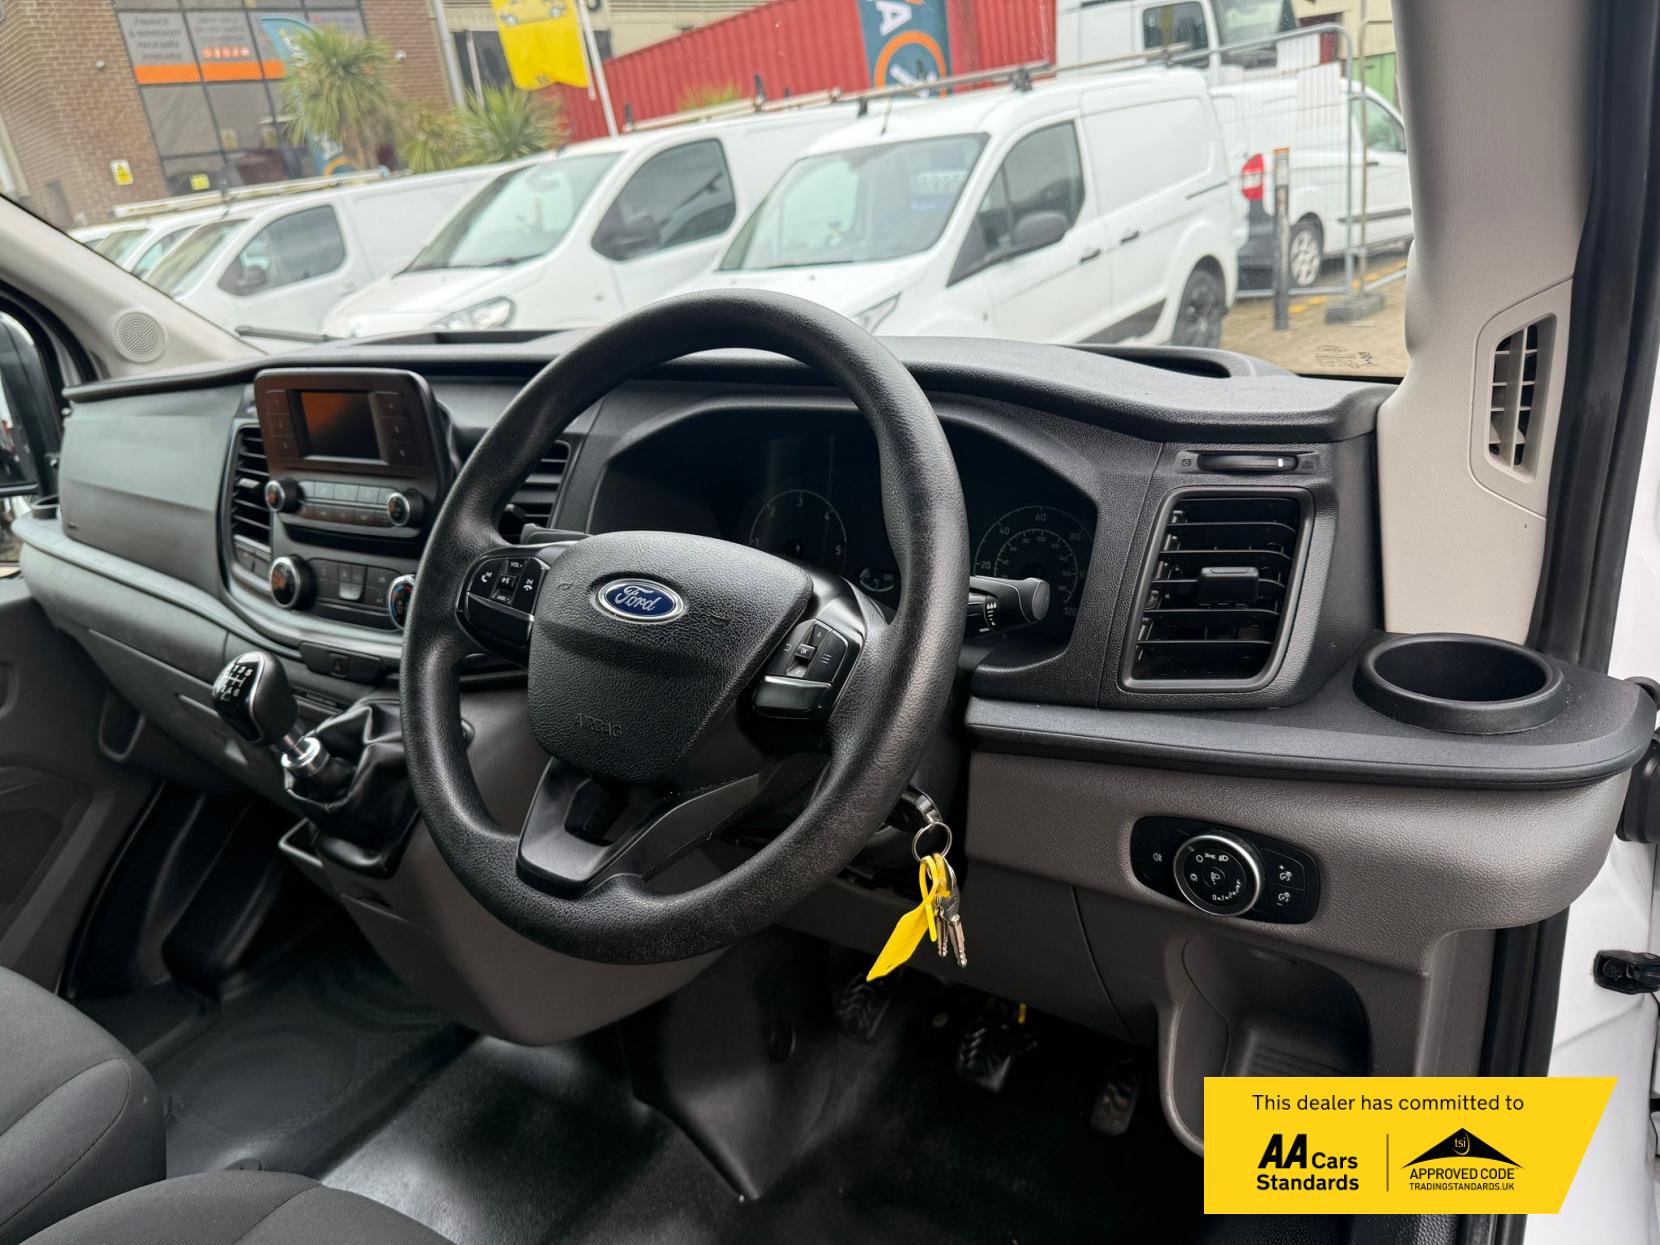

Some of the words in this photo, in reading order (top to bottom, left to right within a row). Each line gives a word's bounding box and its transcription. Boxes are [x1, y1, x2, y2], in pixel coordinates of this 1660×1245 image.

[1034, 512, 1047, 522] 60
[999, 526, 1011, 536] 40
[980, 560, 991, 570] 20
[614, 585, 662, 612] Ford
